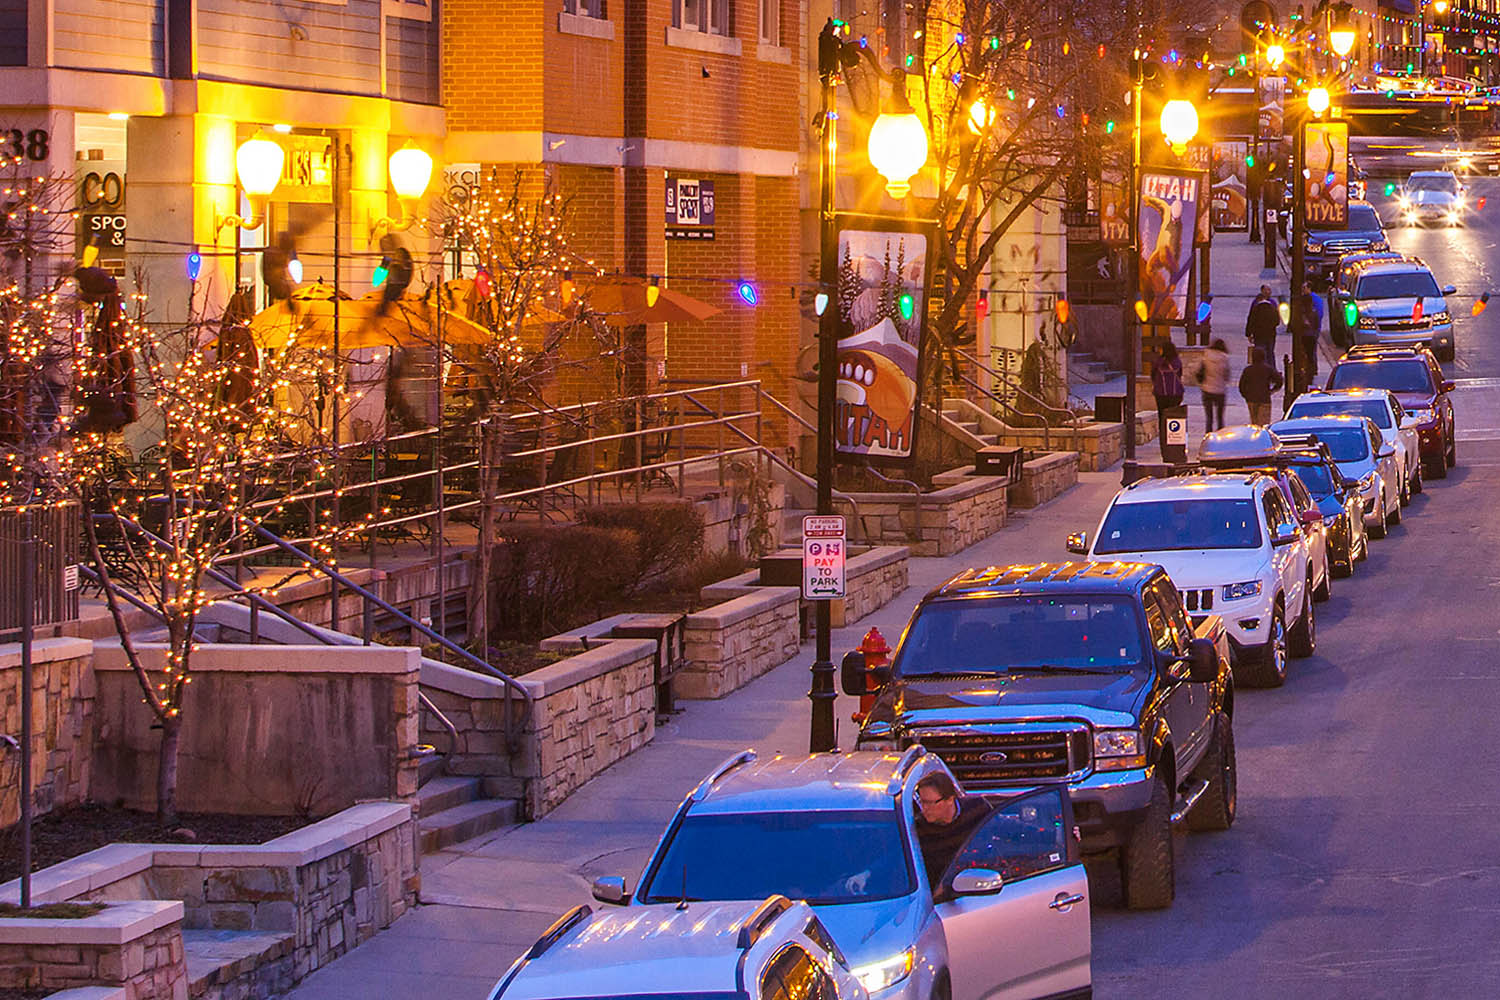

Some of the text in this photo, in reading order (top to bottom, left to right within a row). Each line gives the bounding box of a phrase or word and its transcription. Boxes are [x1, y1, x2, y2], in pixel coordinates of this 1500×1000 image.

[1144, 176, 1197, 203] UTAH
[1305, 202, 1344, 222] STYLE
[91, 215, 127, 231] SPO
[111, 231, 125, 246] &
[836, 403, 914, 452] UTAH
[814, 558, 835, 567] PAY
[818, 567, 832, 576] TO
[810, 577, 839, 586] PARK
